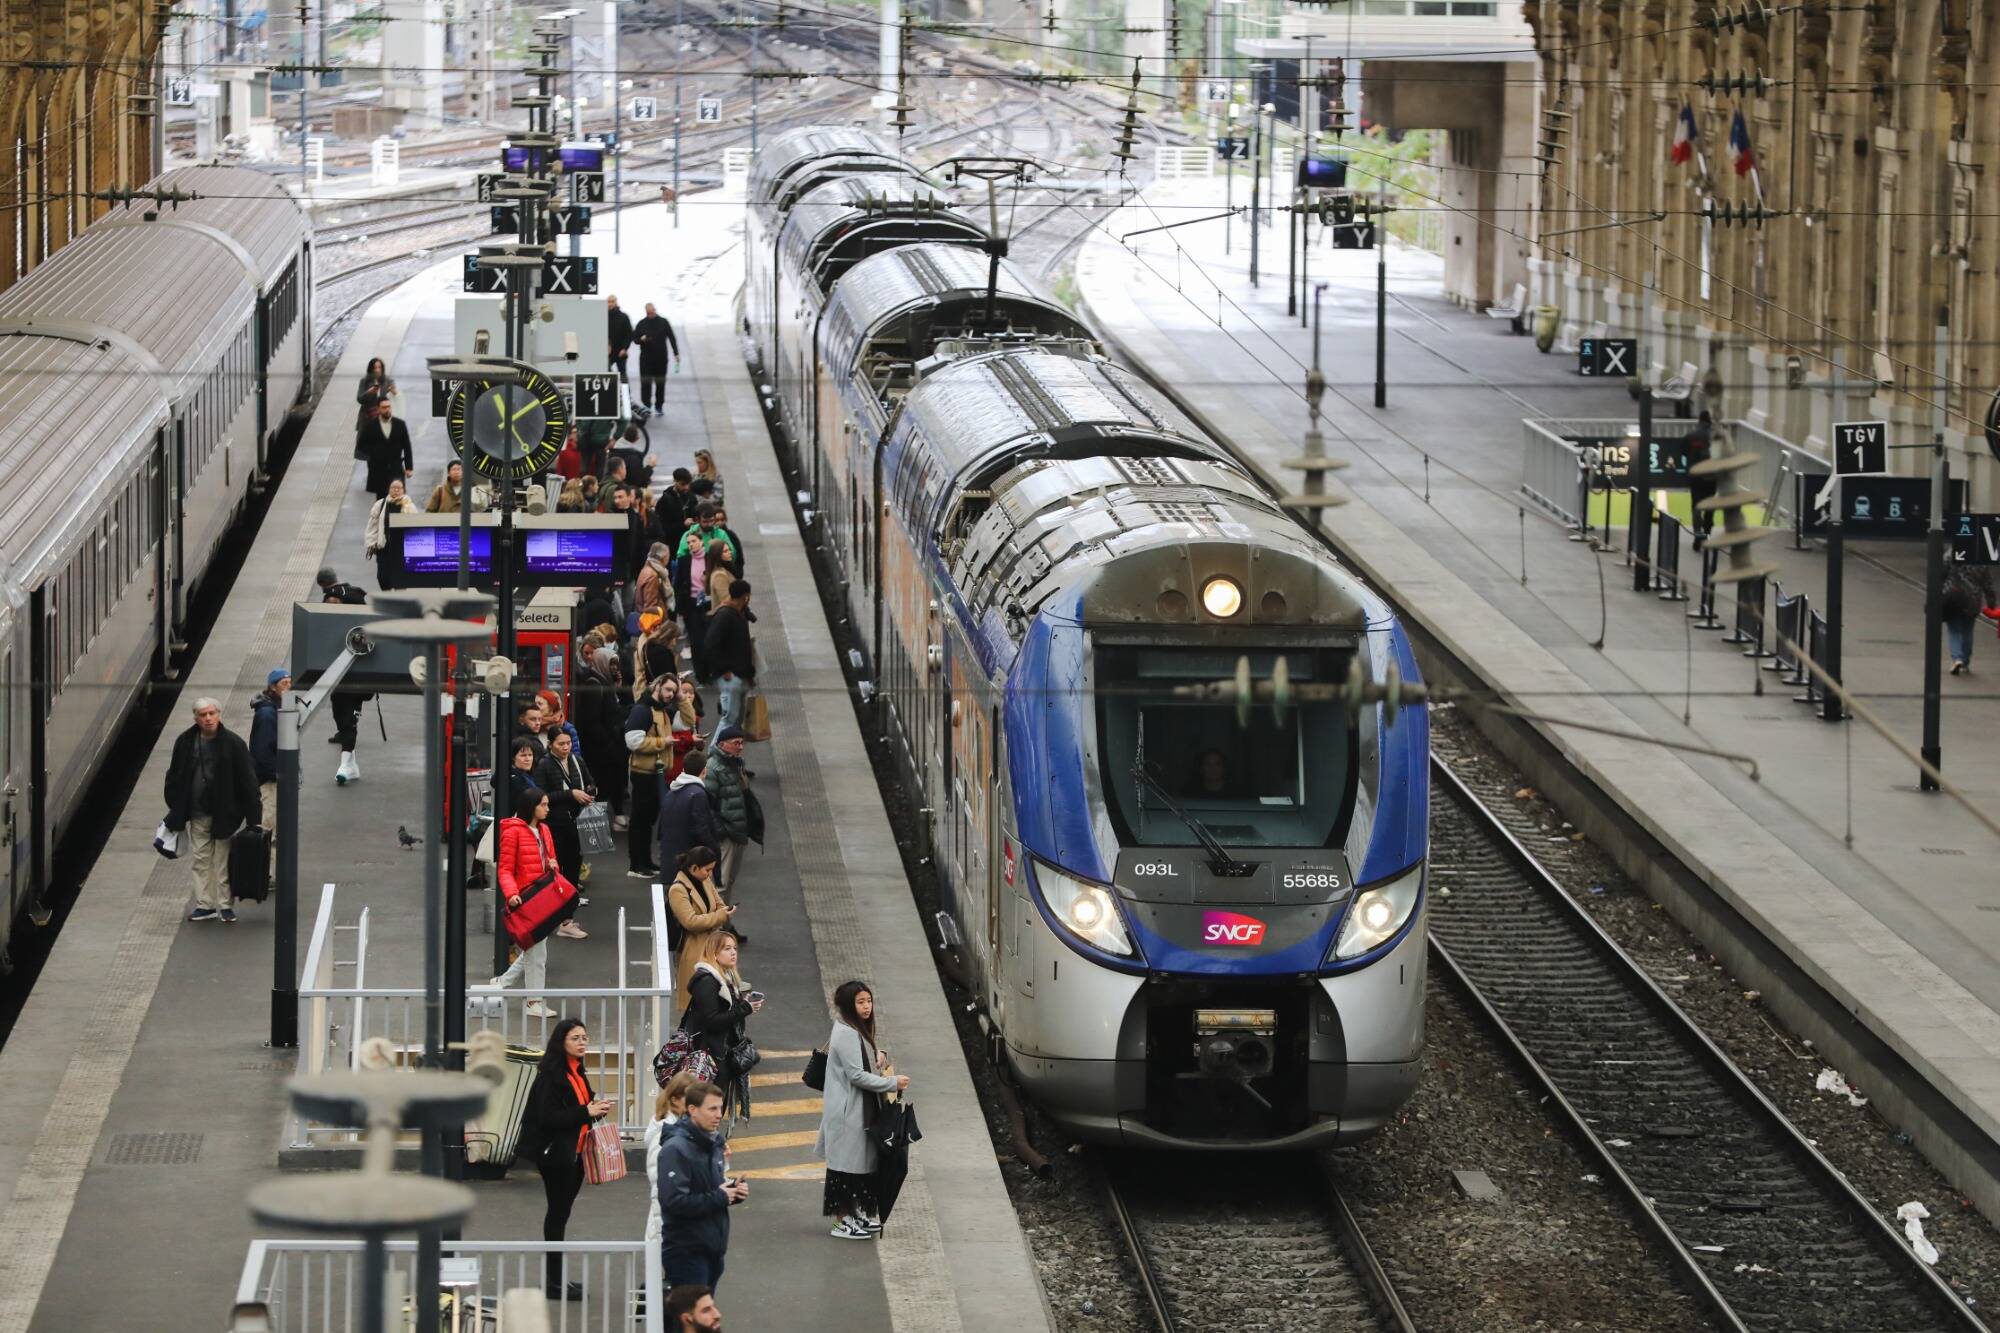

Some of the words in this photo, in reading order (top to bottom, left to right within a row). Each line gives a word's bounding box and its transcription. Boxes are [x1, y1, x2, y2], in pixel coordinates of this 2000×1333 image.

[1231, 142, 1246, 159] Z
[556, 212, 572, 233] Y
[1353, 228, 1369, 248] Y
[490, 267, 508, 291] X
[550, 265, 572, 292] X
[1604, 347, 1627, 373] X
[583, 378, 611, 391] TGV
[590, 393, 600, 415] 1
[1844, 428, 1876, 443] TGV
[1853, 446, 1864, 471] 1
[519, 613, 559, 623] selecta
[1135, 863, 1178, 876] 093L
[1283, 874, 1340, 888] 55685
[1205, 924, 1262, 941] SNCF
